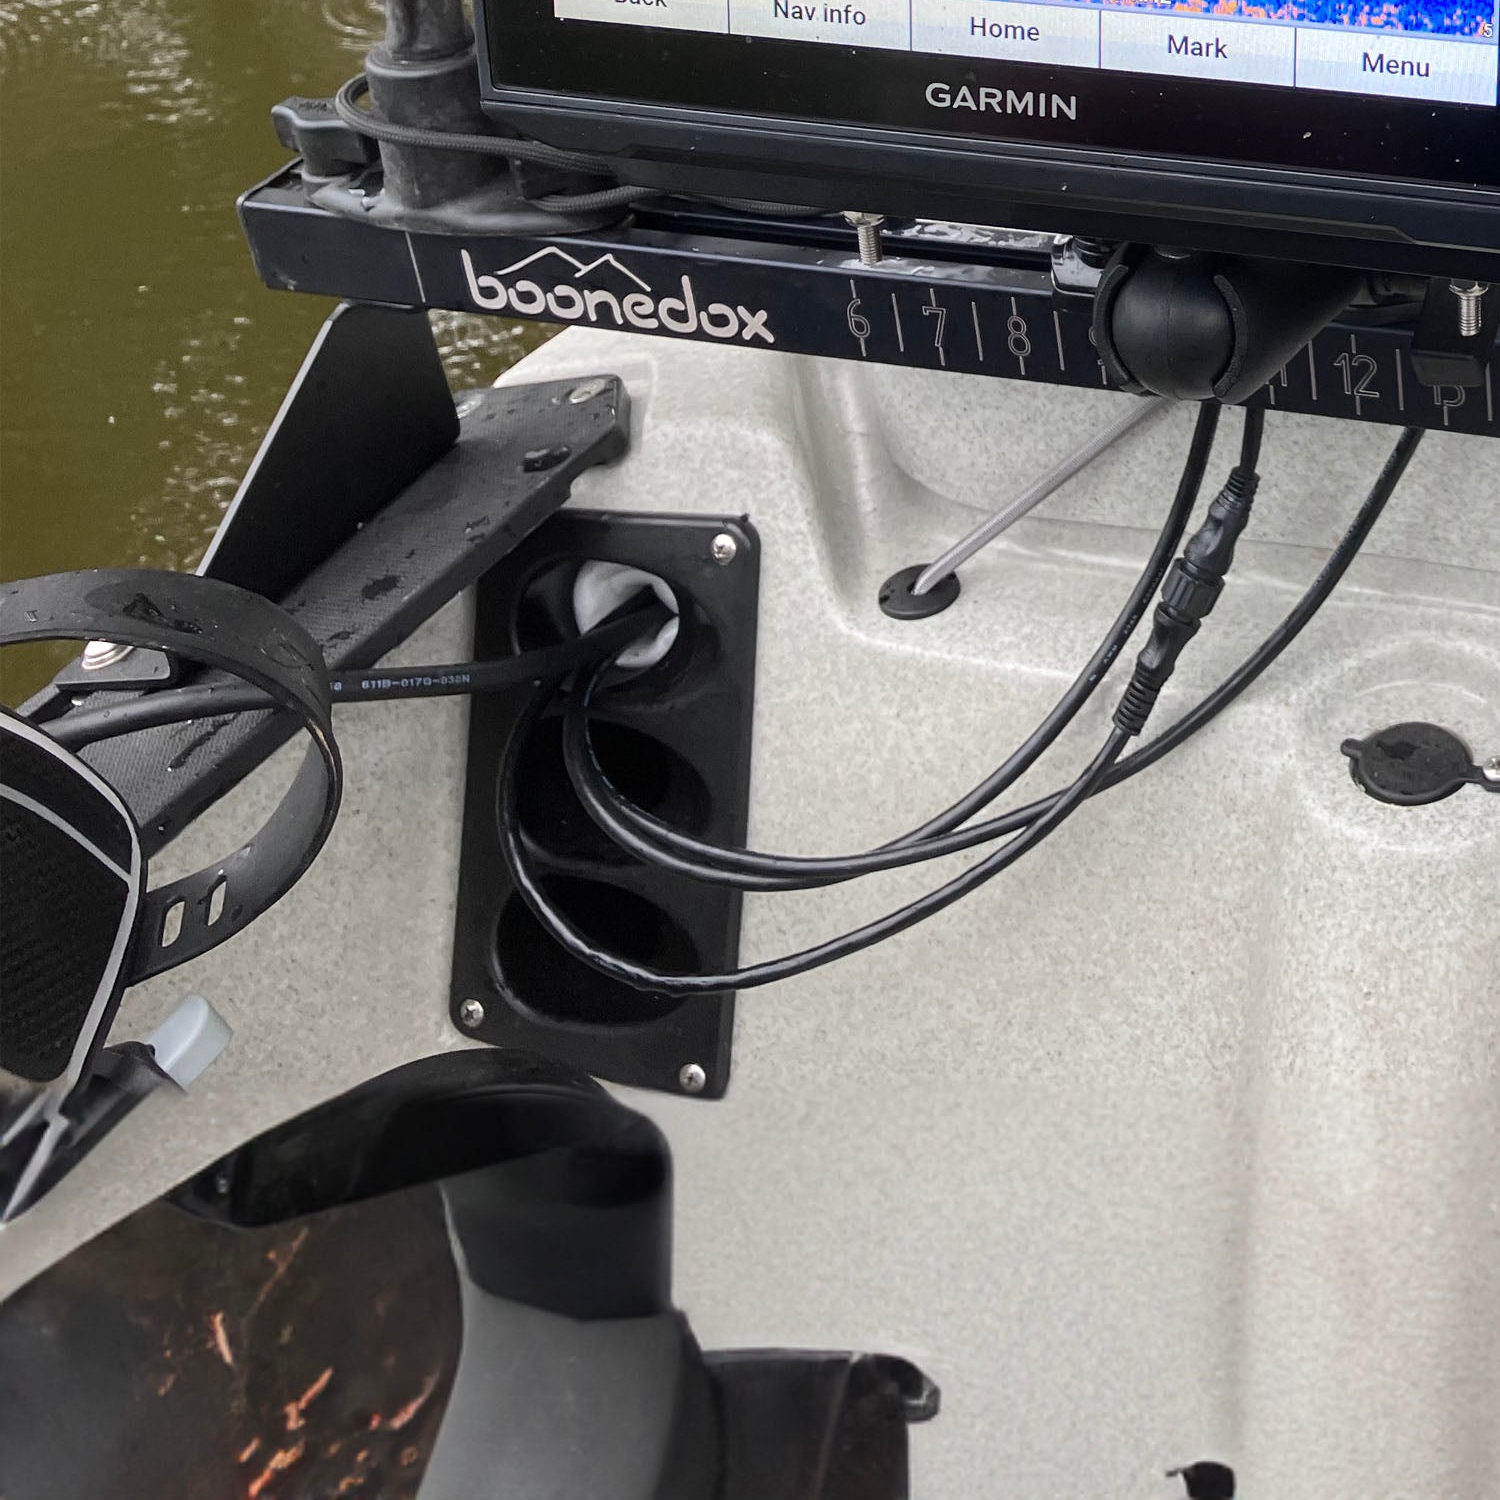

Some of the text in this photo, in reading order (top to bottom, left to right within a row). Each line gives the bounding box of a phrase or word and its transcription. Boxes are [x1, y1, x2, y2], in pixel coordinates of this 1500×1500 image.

[773, 0, 866, 26] Nav info
[970, 16, 1040, 42] Home
[1167, 34, 1228, 61] Mark
[1362, 52, 1430, 78] Menu
[925, 82, 1077, 120] GARMIN
[461, 249, 776, 344] boonedox
[846, 298, 871, 339] 6
[922, 305, 947, 348] 7
[1006, 315, 1032, 357] 8
[1334, 351, 1380, 399] 12
